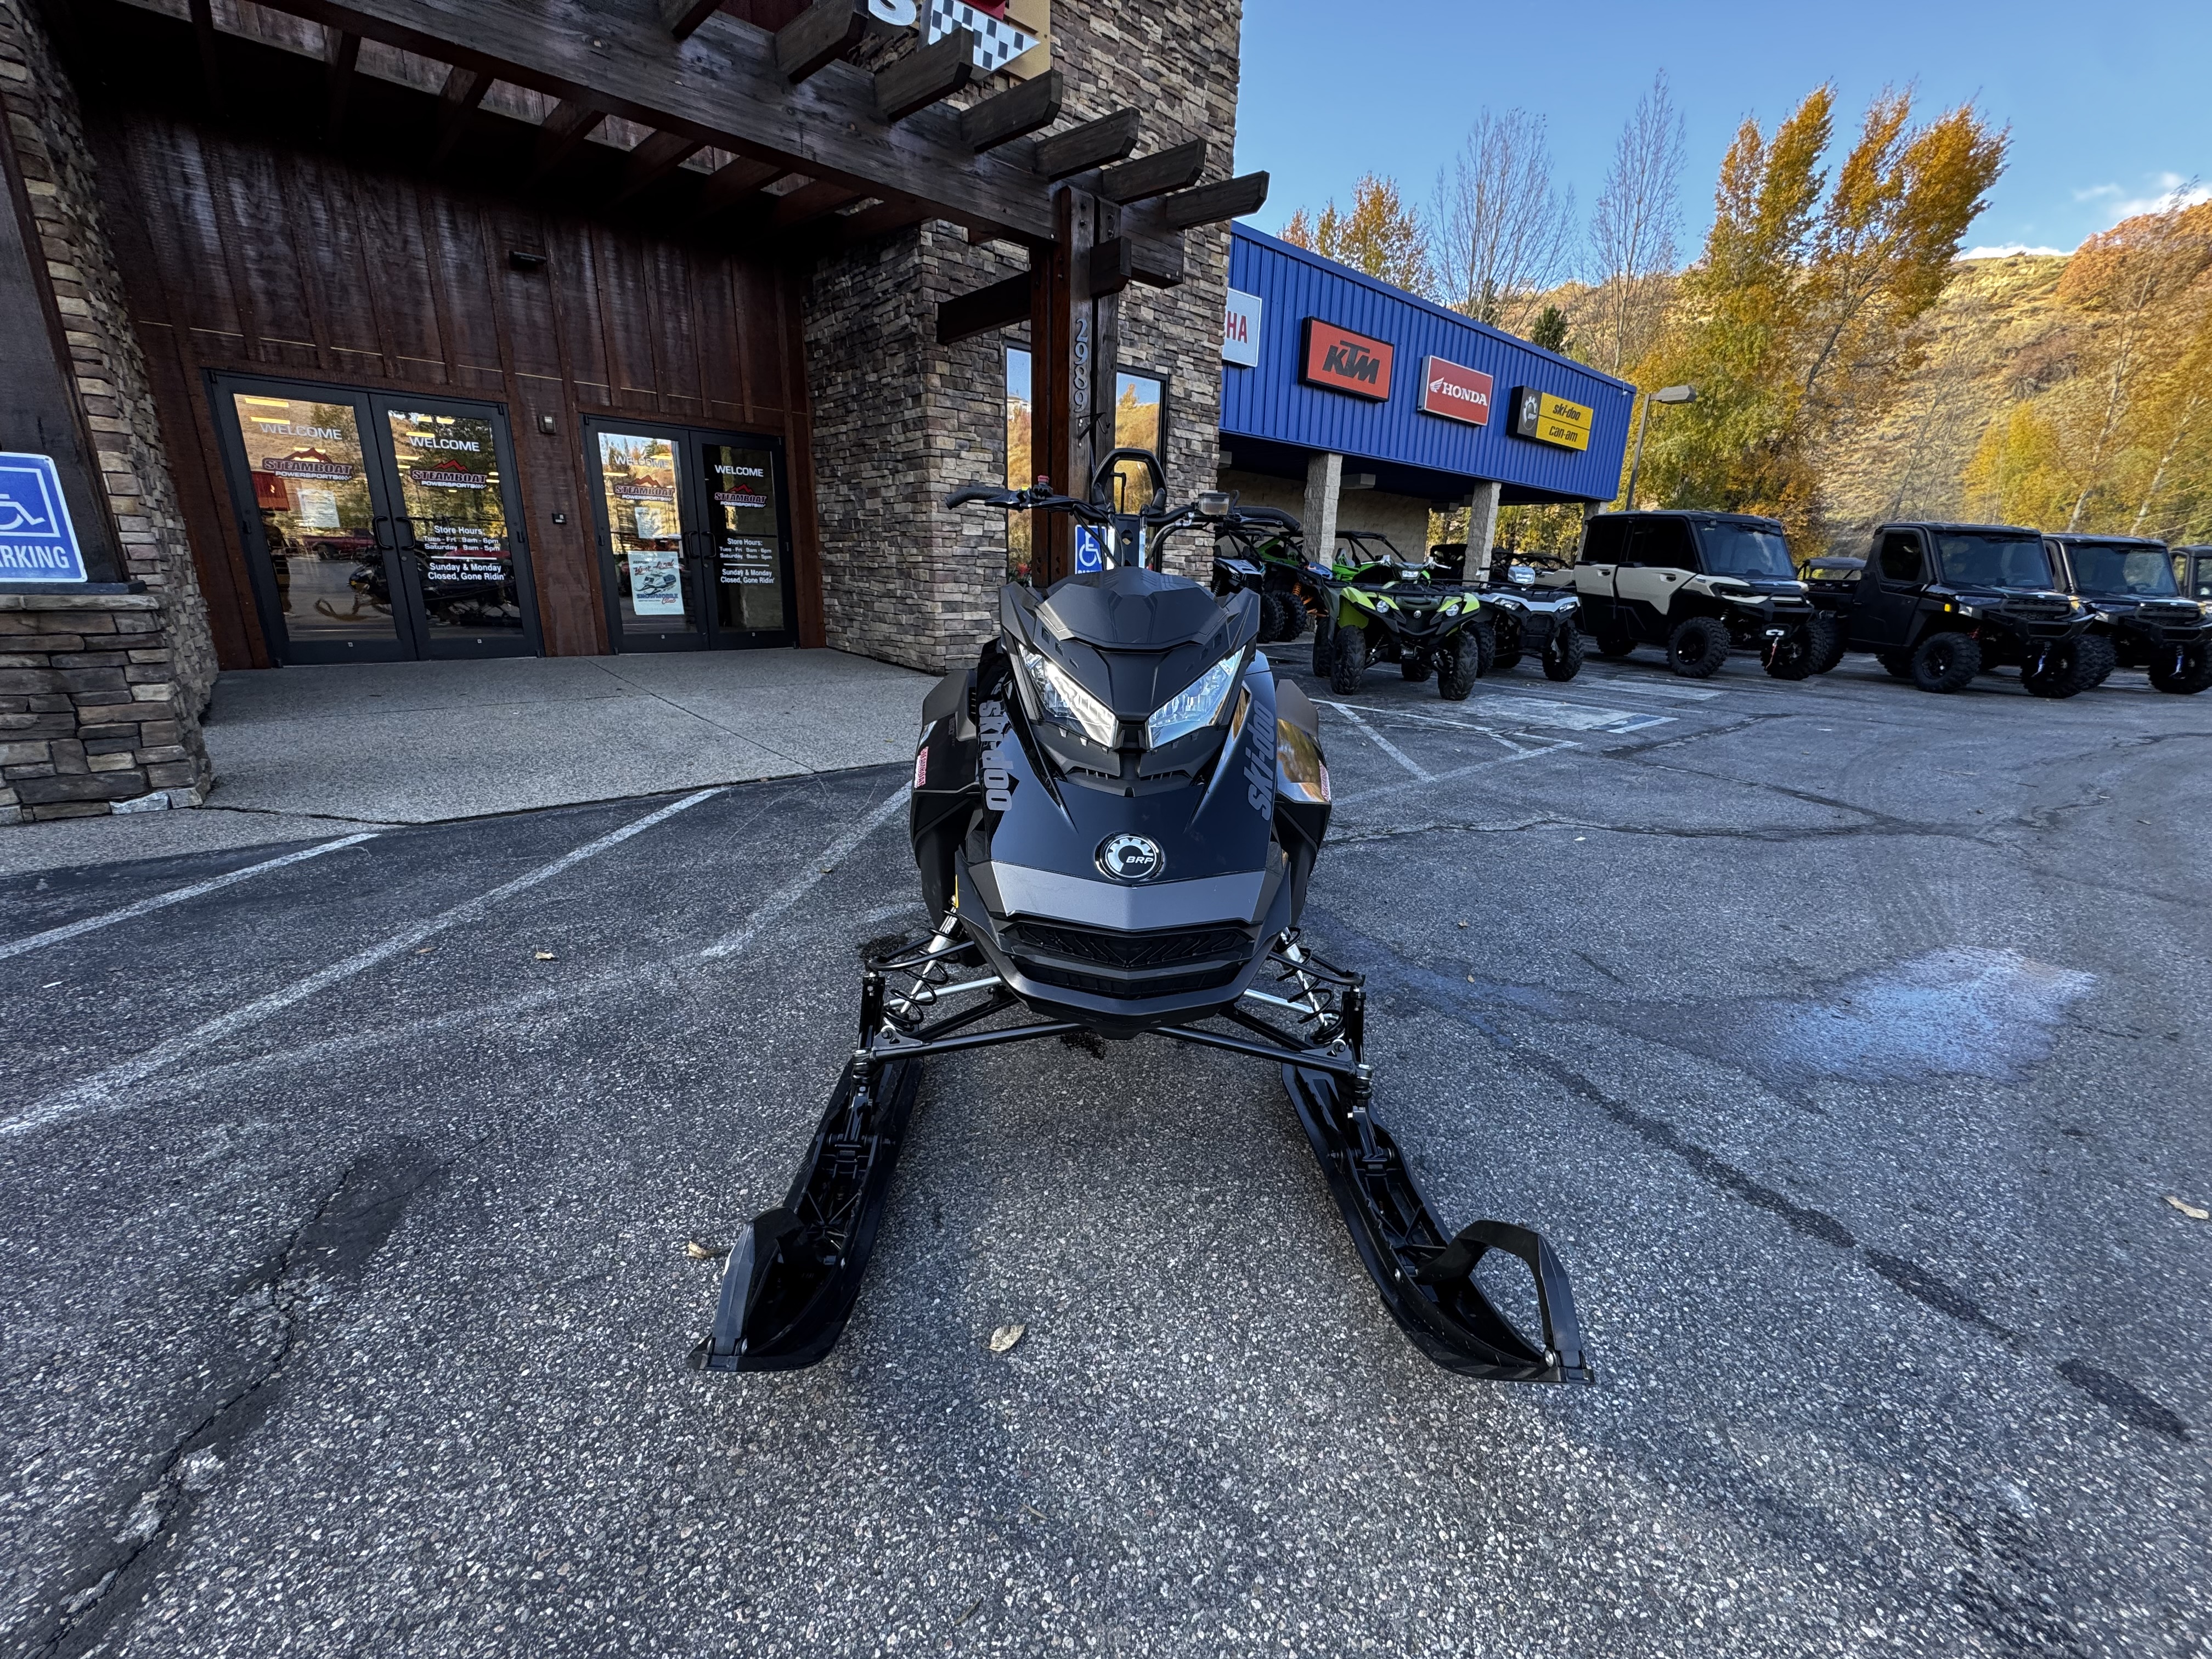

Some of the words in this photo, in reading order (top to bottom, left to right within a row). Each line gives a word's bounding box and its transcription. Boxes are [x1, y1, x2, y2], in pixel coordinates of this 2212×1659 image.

[1073, 317, 1088, 413] 2989
[1322, 340, 1380, 385] KTM
[1442, 382, 1488, 406] HONDA
[1552, 403, 1581, 421] ski-doo
[259, 422, 343, 440] WELCOME
[1549, 425, 1578, 443] can-am
[409, 436, 481, 452] WELCOME
[264, 459, 352, 475] STEAMBOAT
[613, 455, 668, 468] WELCOME
[275, 471, 338, 479] POWERSPORTS
[412, 470, 487, 483] STEAMBOAT
[714, 464, 764, 477] WELCOME
[421, 481, 476, 489] POWERSPORTS
[615, 485, 674, 496] STEAMBOAT
[714, 492, 767, 503] STEAMBOAT
[434, 525, 456, 534] Store
[458, 526, 486, 535] Hours:
[0, 545, 70, 568] RKING
[430, 562, 460, 572] Sunday
[471, 563, 501, 573] Monday
[722, 568, 743, 577] Sunday
[751, 569, 772, 578] Monday
[428, 572, 459, 581] Closed,
[1244, 699, 1274, 821] ski-doo
[1126, 856, 1154, 864] BRP
